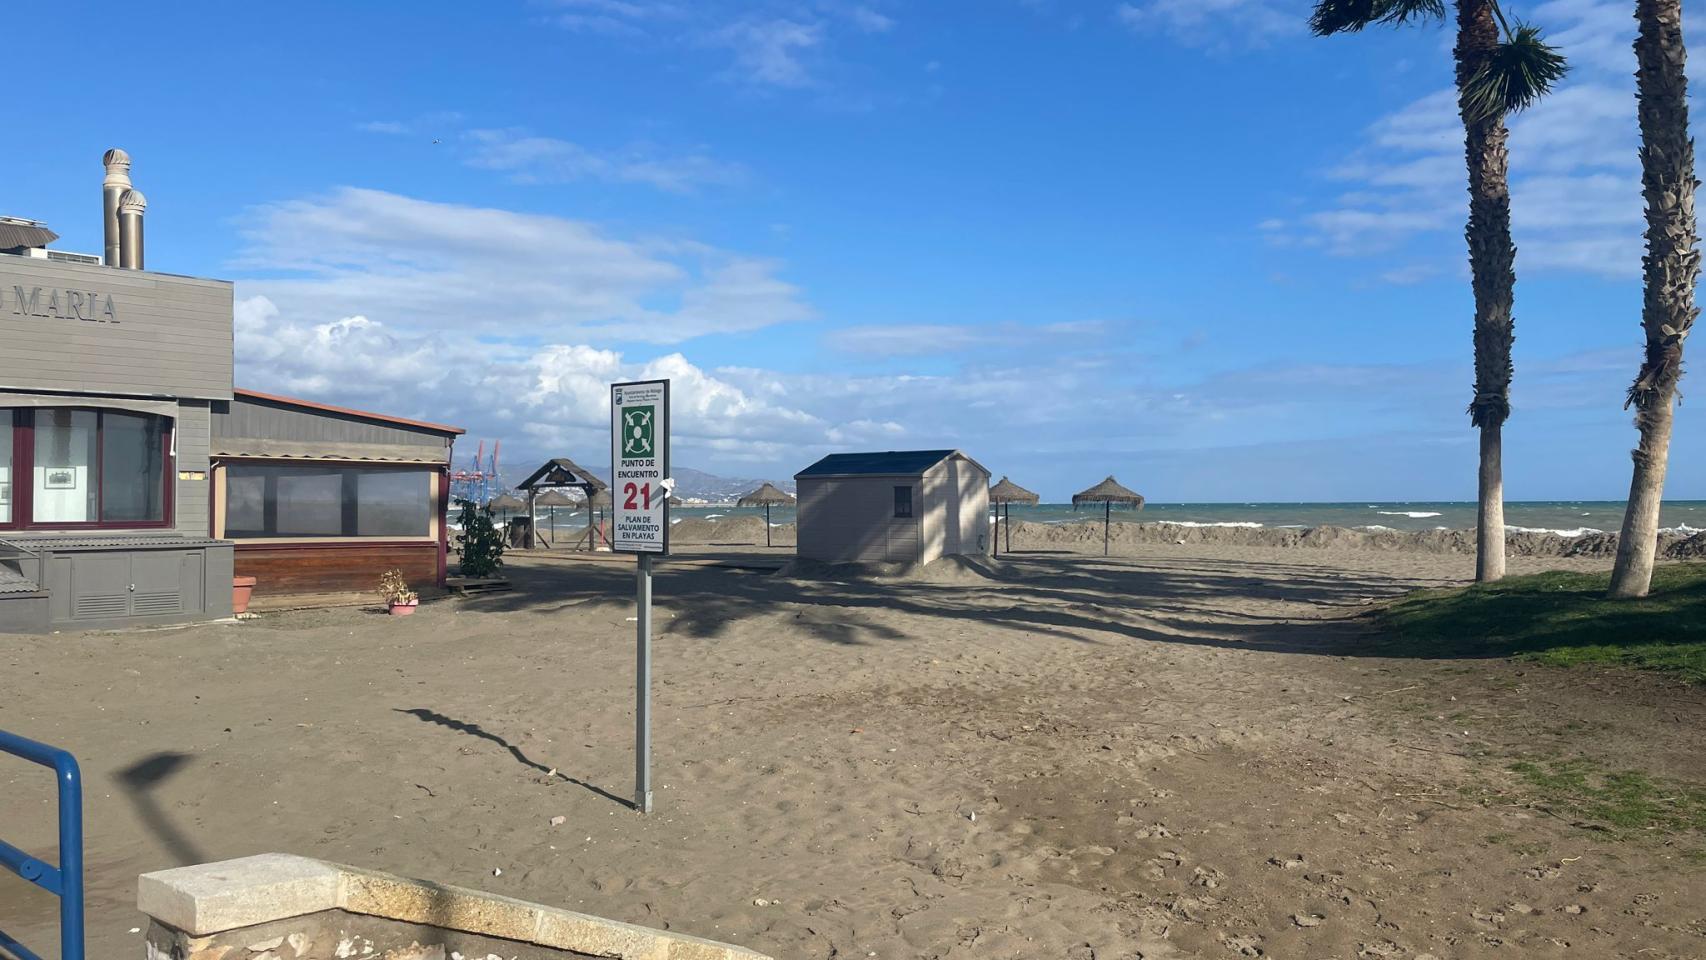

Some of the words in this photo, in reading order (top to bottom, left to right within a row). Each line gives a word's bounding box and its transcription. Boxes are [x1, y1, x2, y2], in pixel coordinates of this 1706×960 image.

[13, 285, 121, 323] MARIA
[621, 459, 644, 467] PUNTO
[645, 459, 655, 467] DE
[618, 470, 658, 478] ENCUENTRO
[624, 482, 650, 510] 21
[618, 524, 659, 532] SALVAMENTO
[631, 532, 655, 540] PLAYAS
